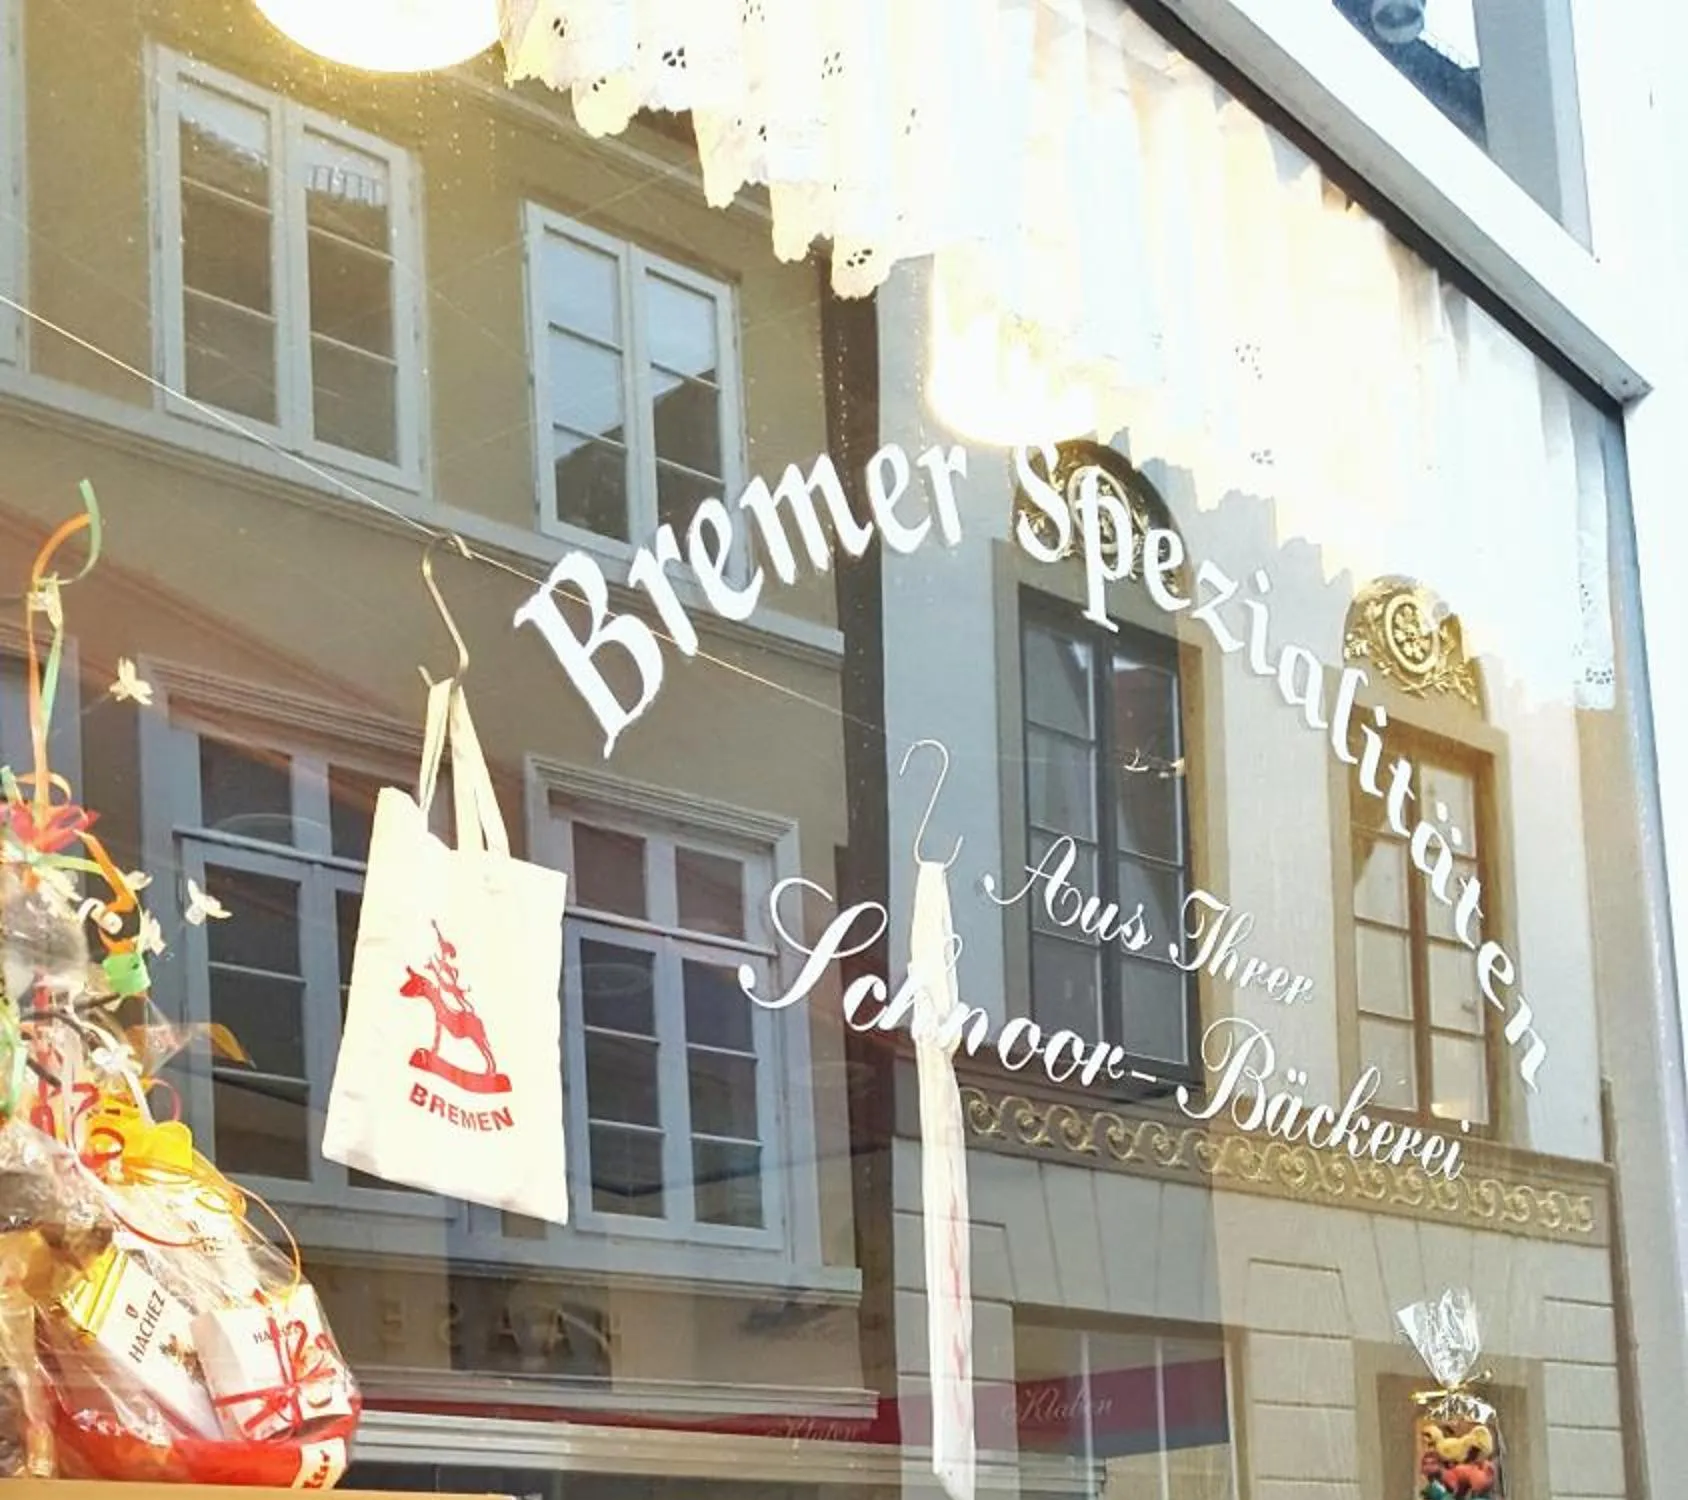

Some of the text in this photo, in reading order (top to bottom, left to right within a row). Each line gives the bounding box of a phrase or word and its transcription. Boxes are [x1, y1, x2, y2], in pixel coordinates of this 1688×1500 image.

[513, 442, 1547, 1092] Bremer Spezialitäten
[984, 835, 1316, 1005] Aus Ihrer
[409, 1083, 515, 1132] BREMEN
[129, 1290, 166, 1364] HACHEZ
[1001, 1382, 1114, 1424] Klaben
